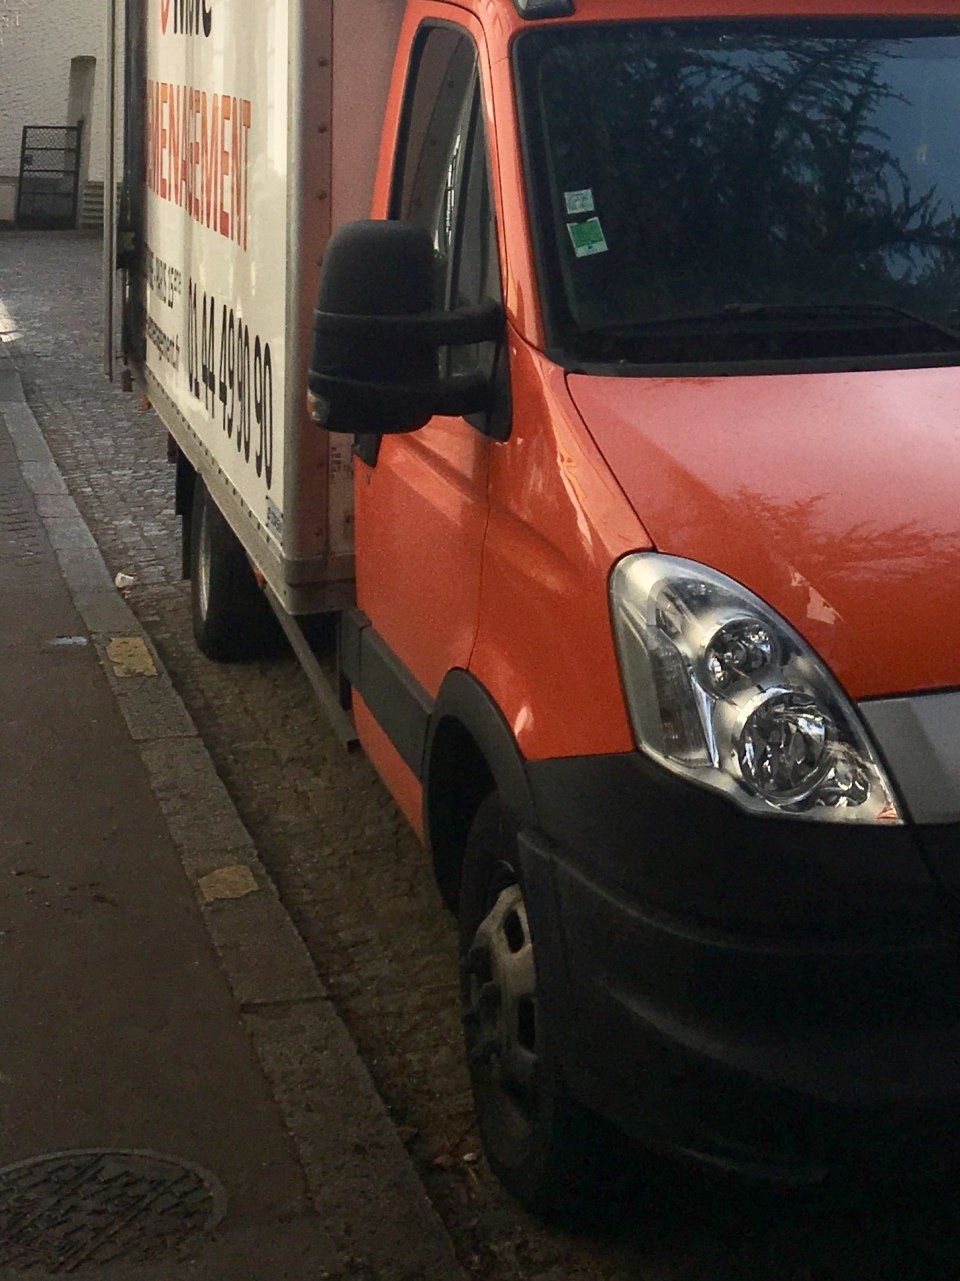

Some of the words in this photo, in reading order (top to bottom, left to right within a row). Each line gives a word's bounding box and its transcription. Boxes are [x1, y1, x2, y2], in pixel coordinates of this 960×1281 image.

[188, 276, 199, 399] 01
[202, 291, 216, 419] 44
[219, 305, 235, 438] 49
[237, 318, 251, 463] 90
[254, 335, 273, 490] 90
